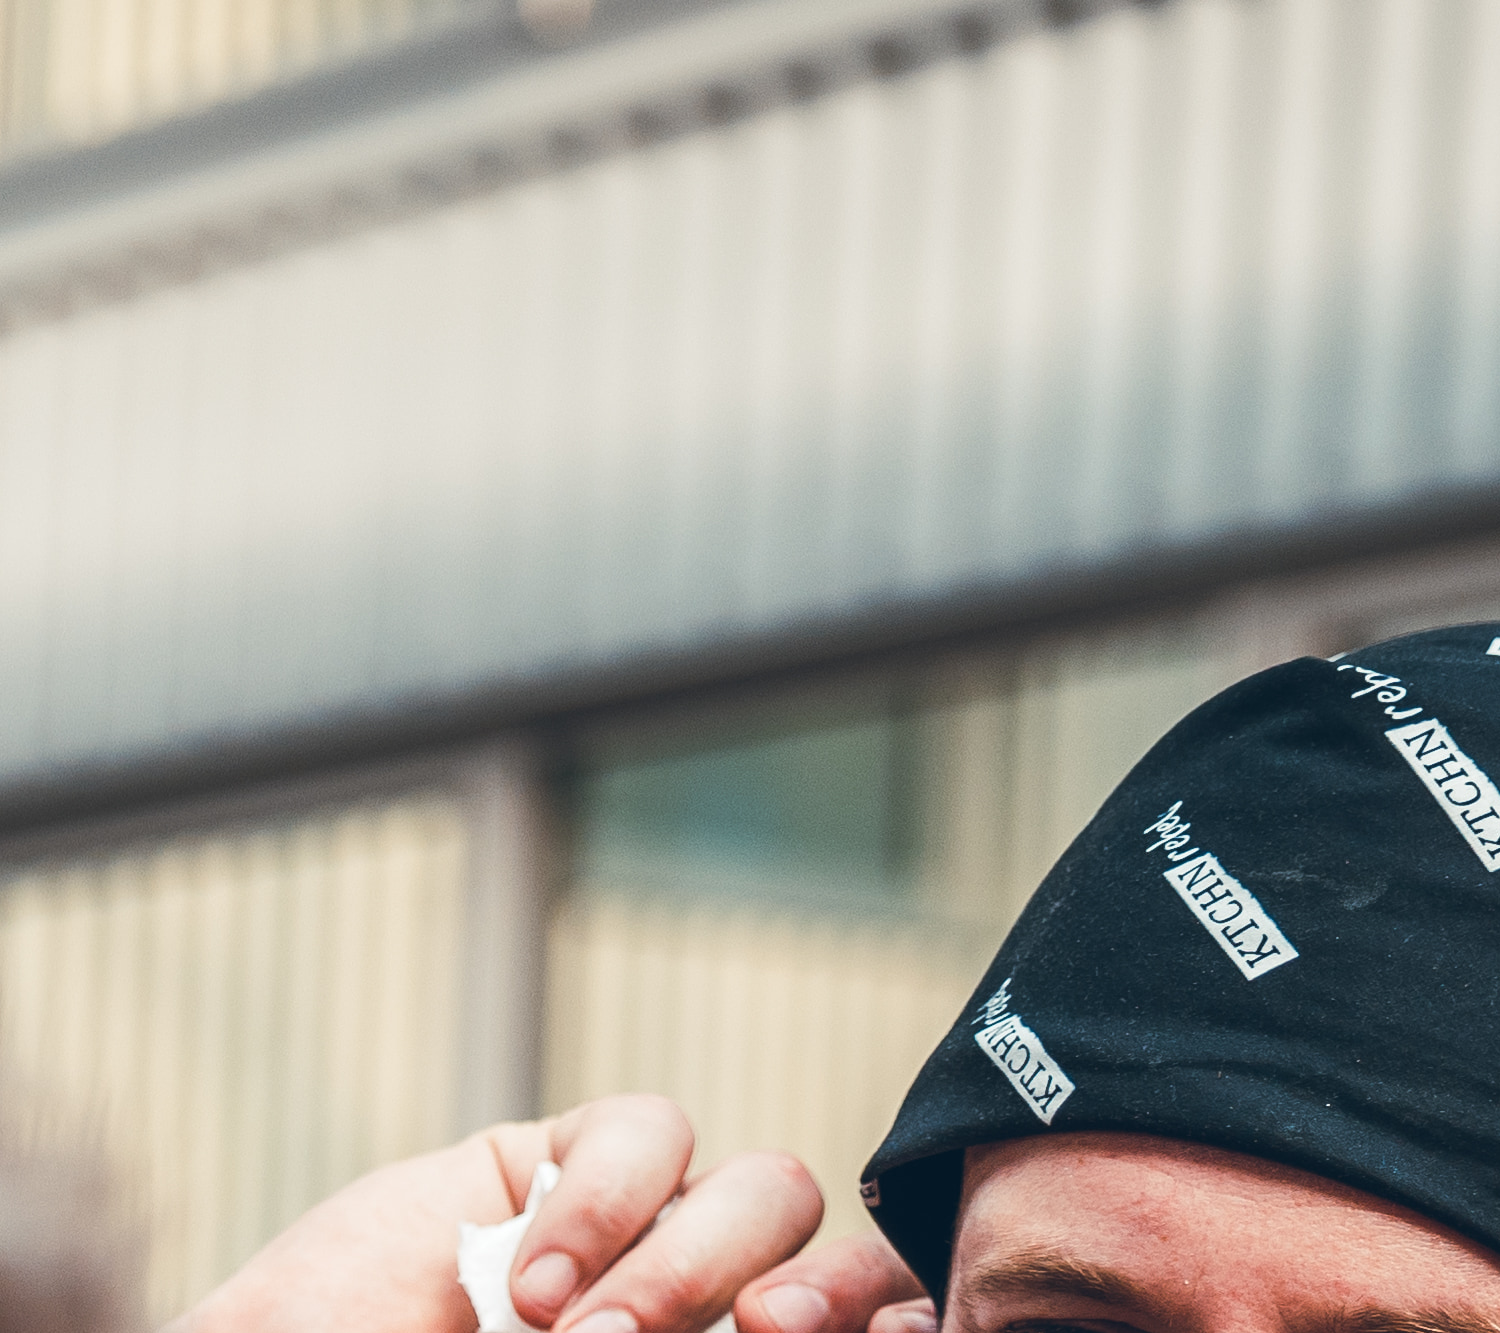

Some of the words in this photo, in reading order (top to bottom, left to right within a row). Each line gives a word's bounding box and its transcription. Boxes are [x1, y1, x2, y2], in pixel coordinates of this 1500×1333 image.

[1336, 663, 1424, 720] reb
[1143, 800, 1200, 862] rebel
[1177, 860, 1281, 969] KTCHN
[984, 1020, 1063, 1114] KTCHN
